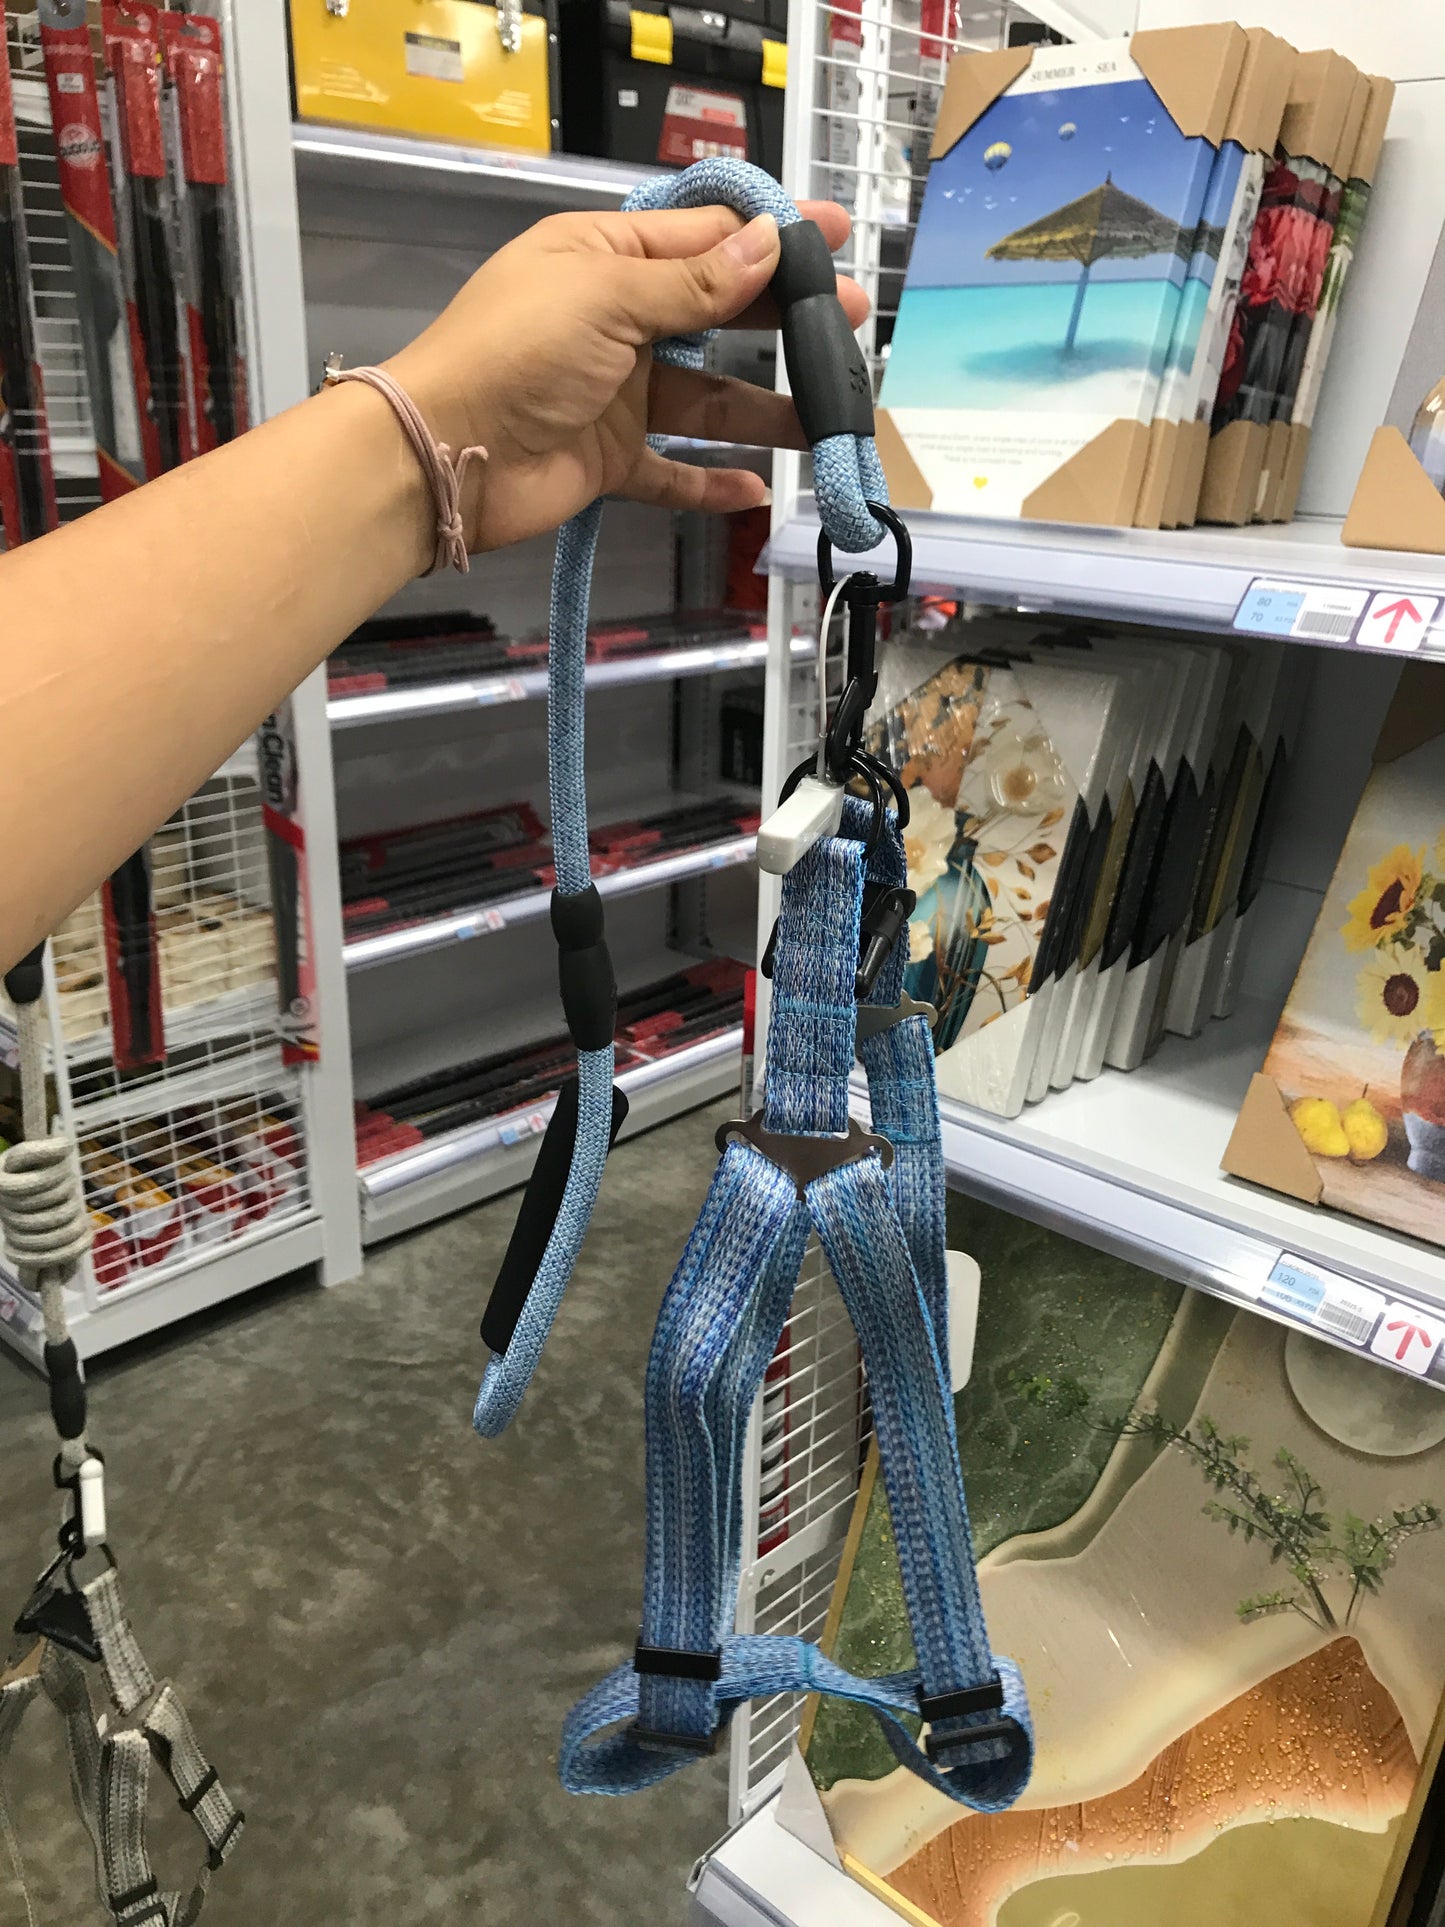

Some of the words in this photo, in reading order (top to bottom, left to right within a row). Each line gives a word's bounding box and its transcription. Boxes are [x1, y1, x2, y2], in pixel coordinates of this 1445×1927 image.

[1030, 66, 1076, 82] SUMMER
[1095, 61, 1117, 74] SEA
[1256, 596, 1272, 607] 80
[1250, 612, 1264, 622] 70
[1278, 1272, 1296, 1287] 120
